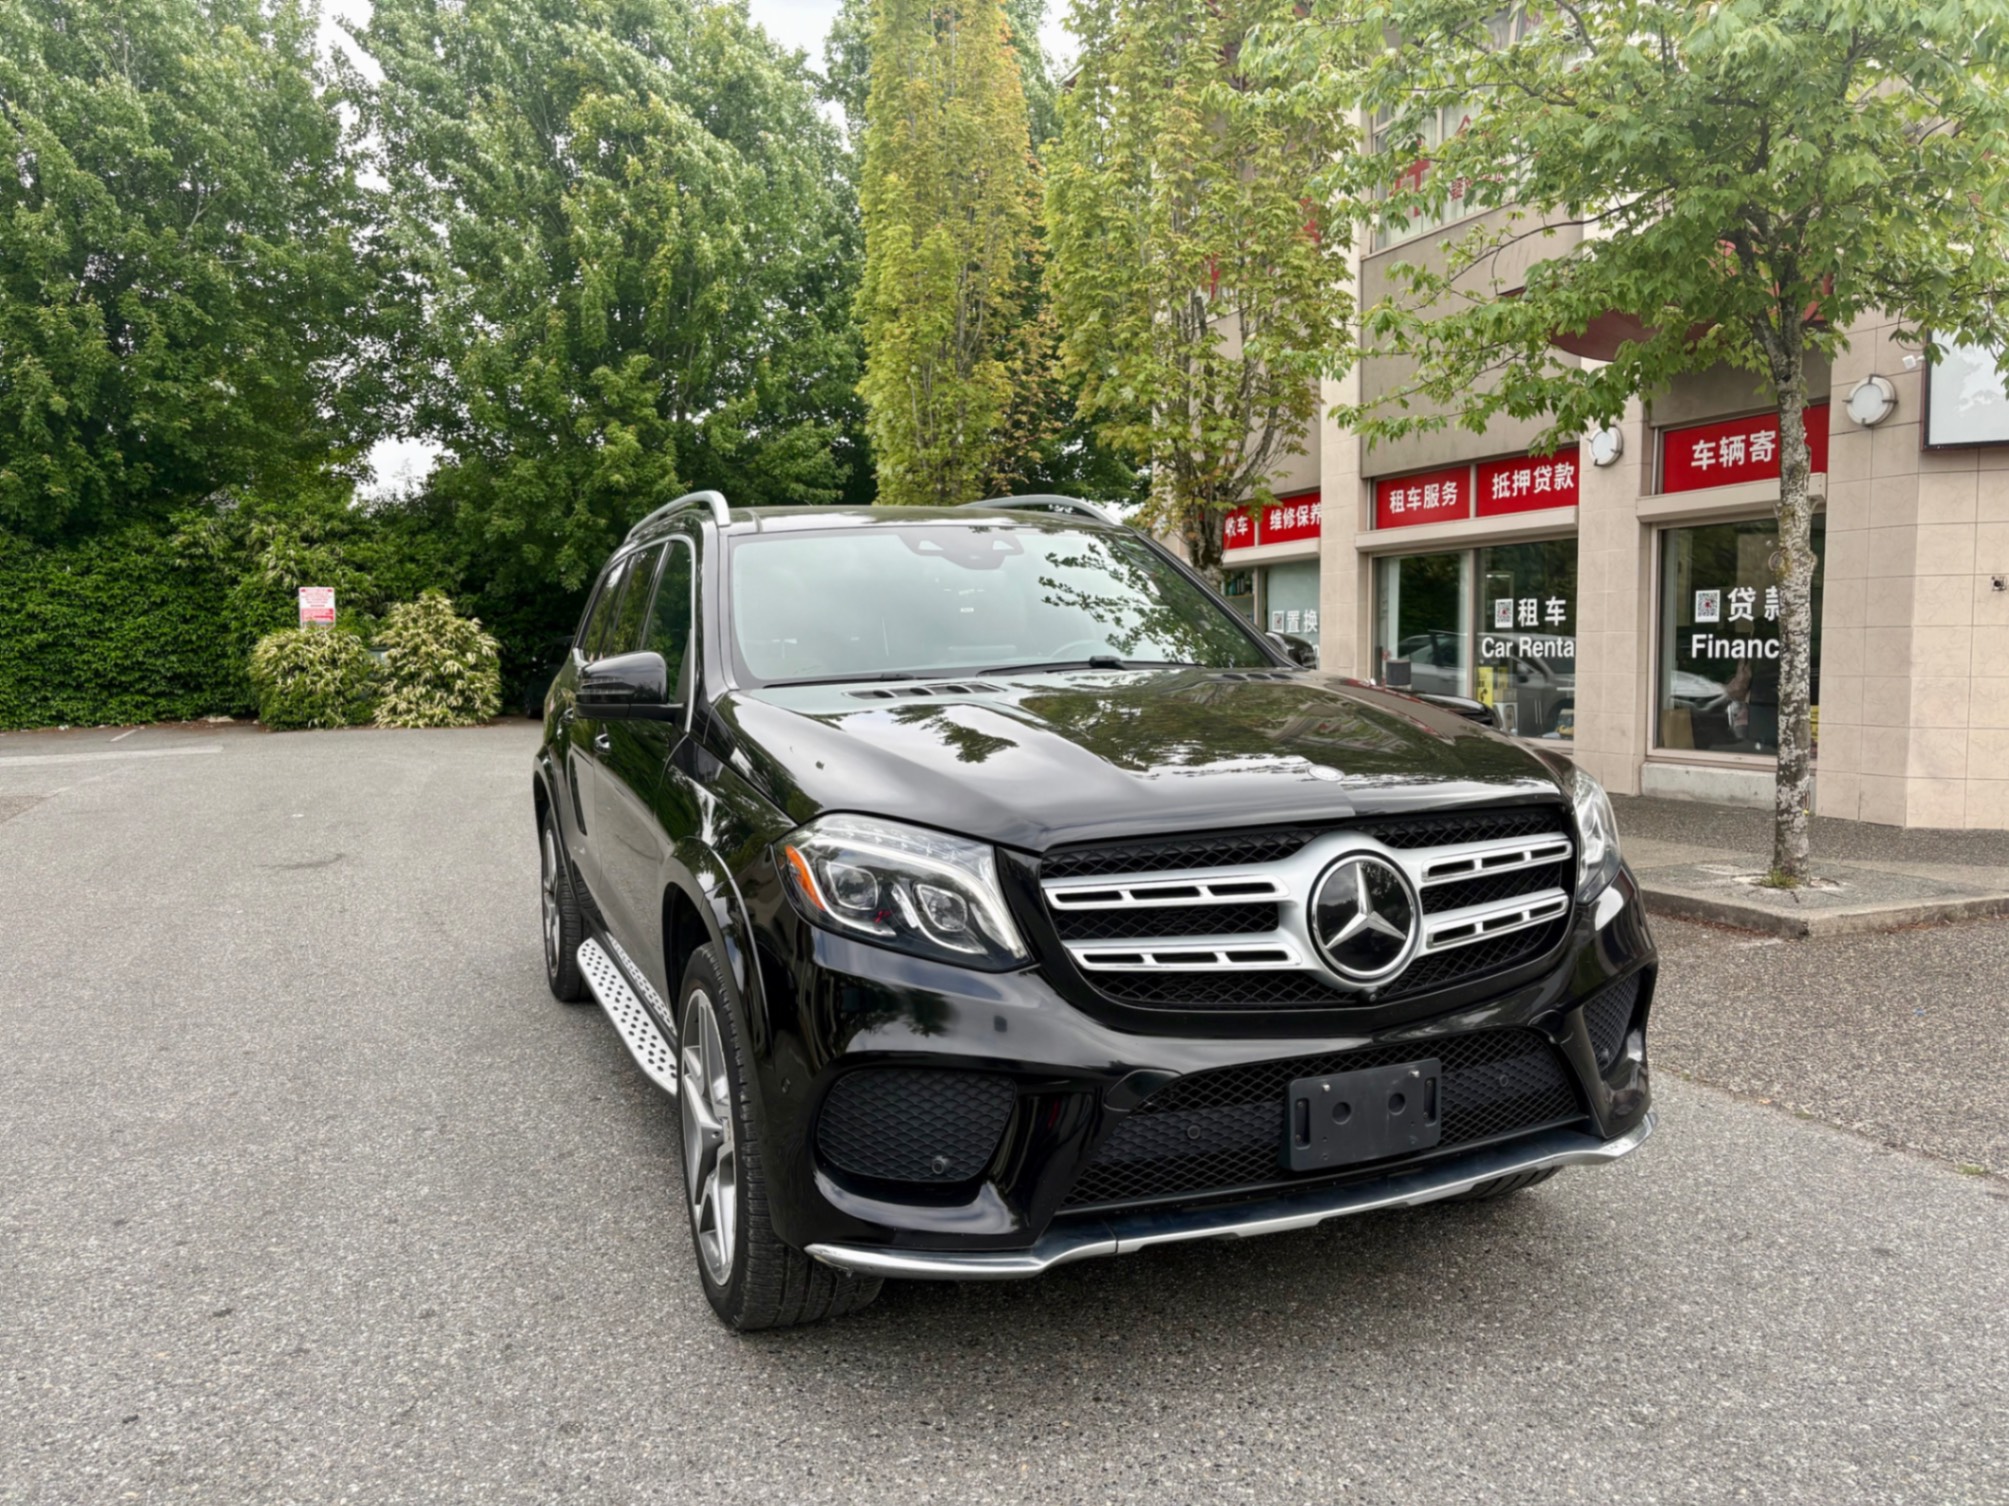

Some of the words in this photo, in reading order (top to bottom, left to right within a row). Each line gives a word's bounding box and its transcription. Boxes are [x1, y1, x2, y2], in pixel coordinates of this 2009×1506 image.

[1690, 429, 1807, 471] 车辆寄
[1491, 461, 1575, 500] 抵押贷款
[1389, 481, 1458, 514] 租车服务
[1269, 502, 1320, 531] 维修保养
[1286, 608, 1318, 633] 置换
[1517, 595, 1567, 627] 租车
[1481, 636, 1513, 658] Car
